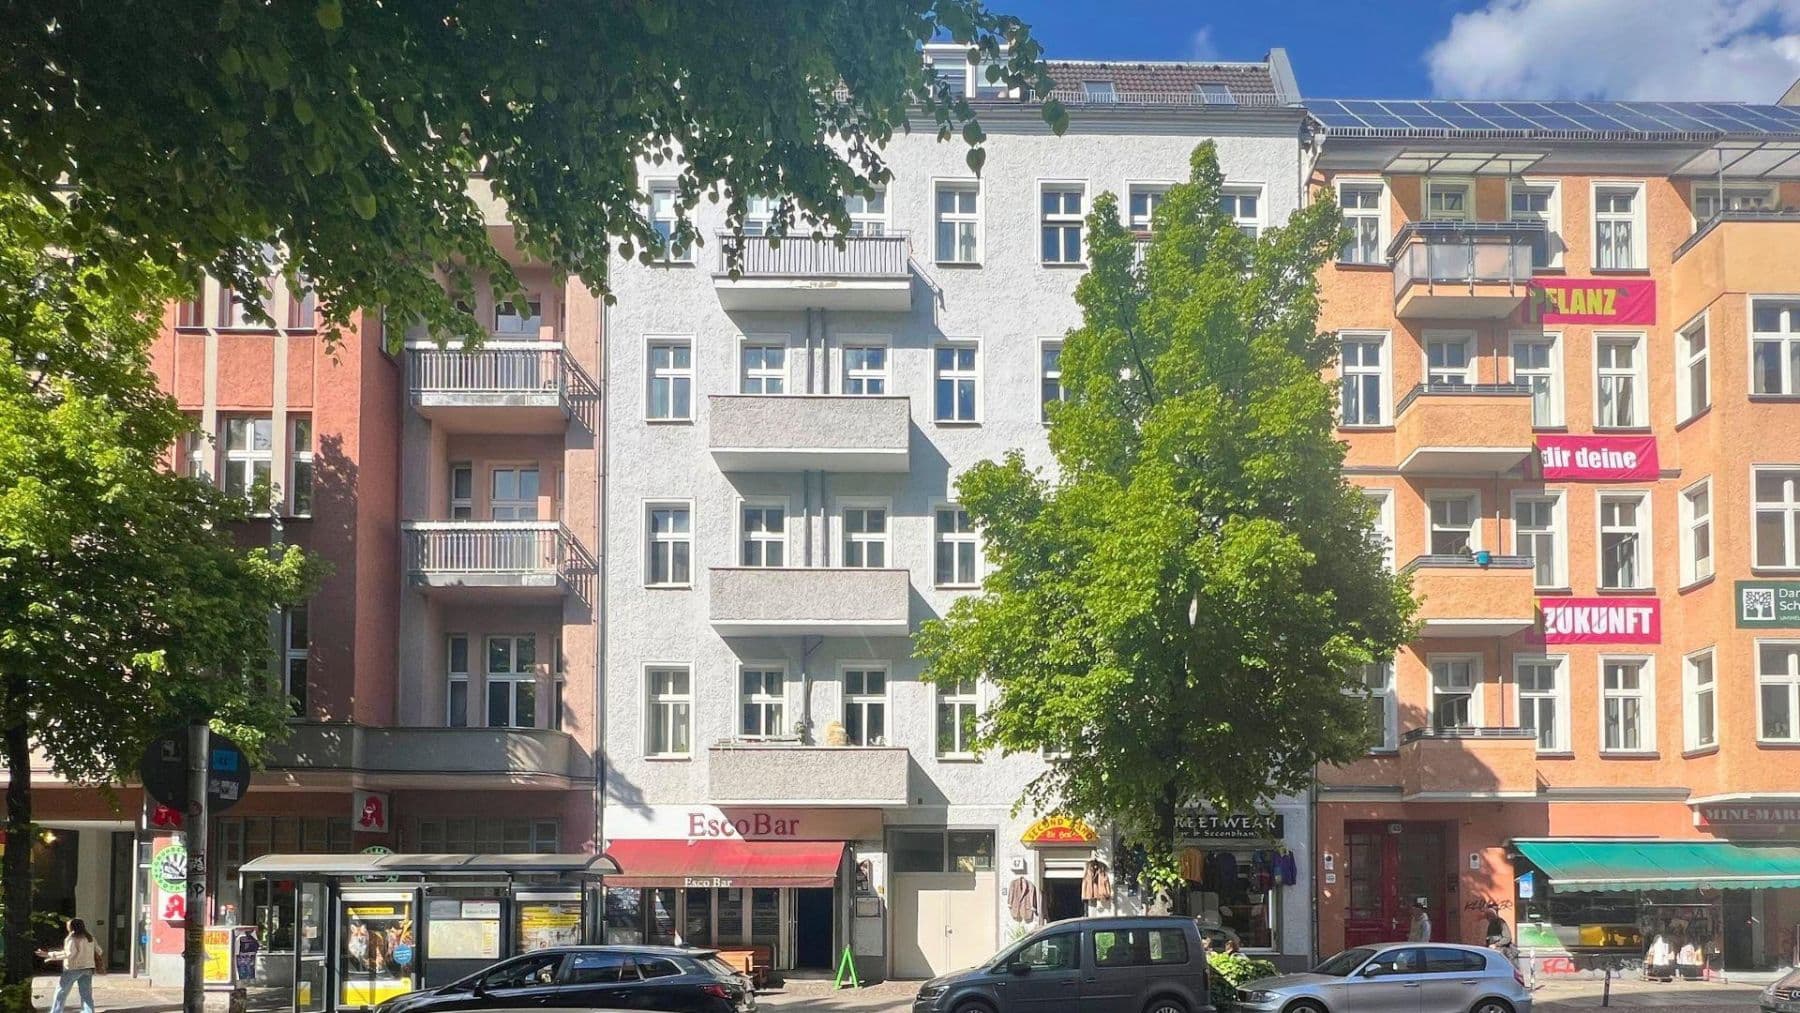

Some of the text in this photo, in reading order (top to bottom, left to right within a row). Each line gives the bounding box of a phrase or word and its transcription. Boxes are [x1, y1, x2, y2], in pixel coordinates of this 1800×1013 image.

[1541, 447, 1637, 469] dir deine
[1543, 606, 1654, 635] ZUKUNFT
[687, 812, 800, 837] EscoBar
[1705, 807, 1800, 820] MINI-MAR
[684, 877, 733, 888] Esco Bar
